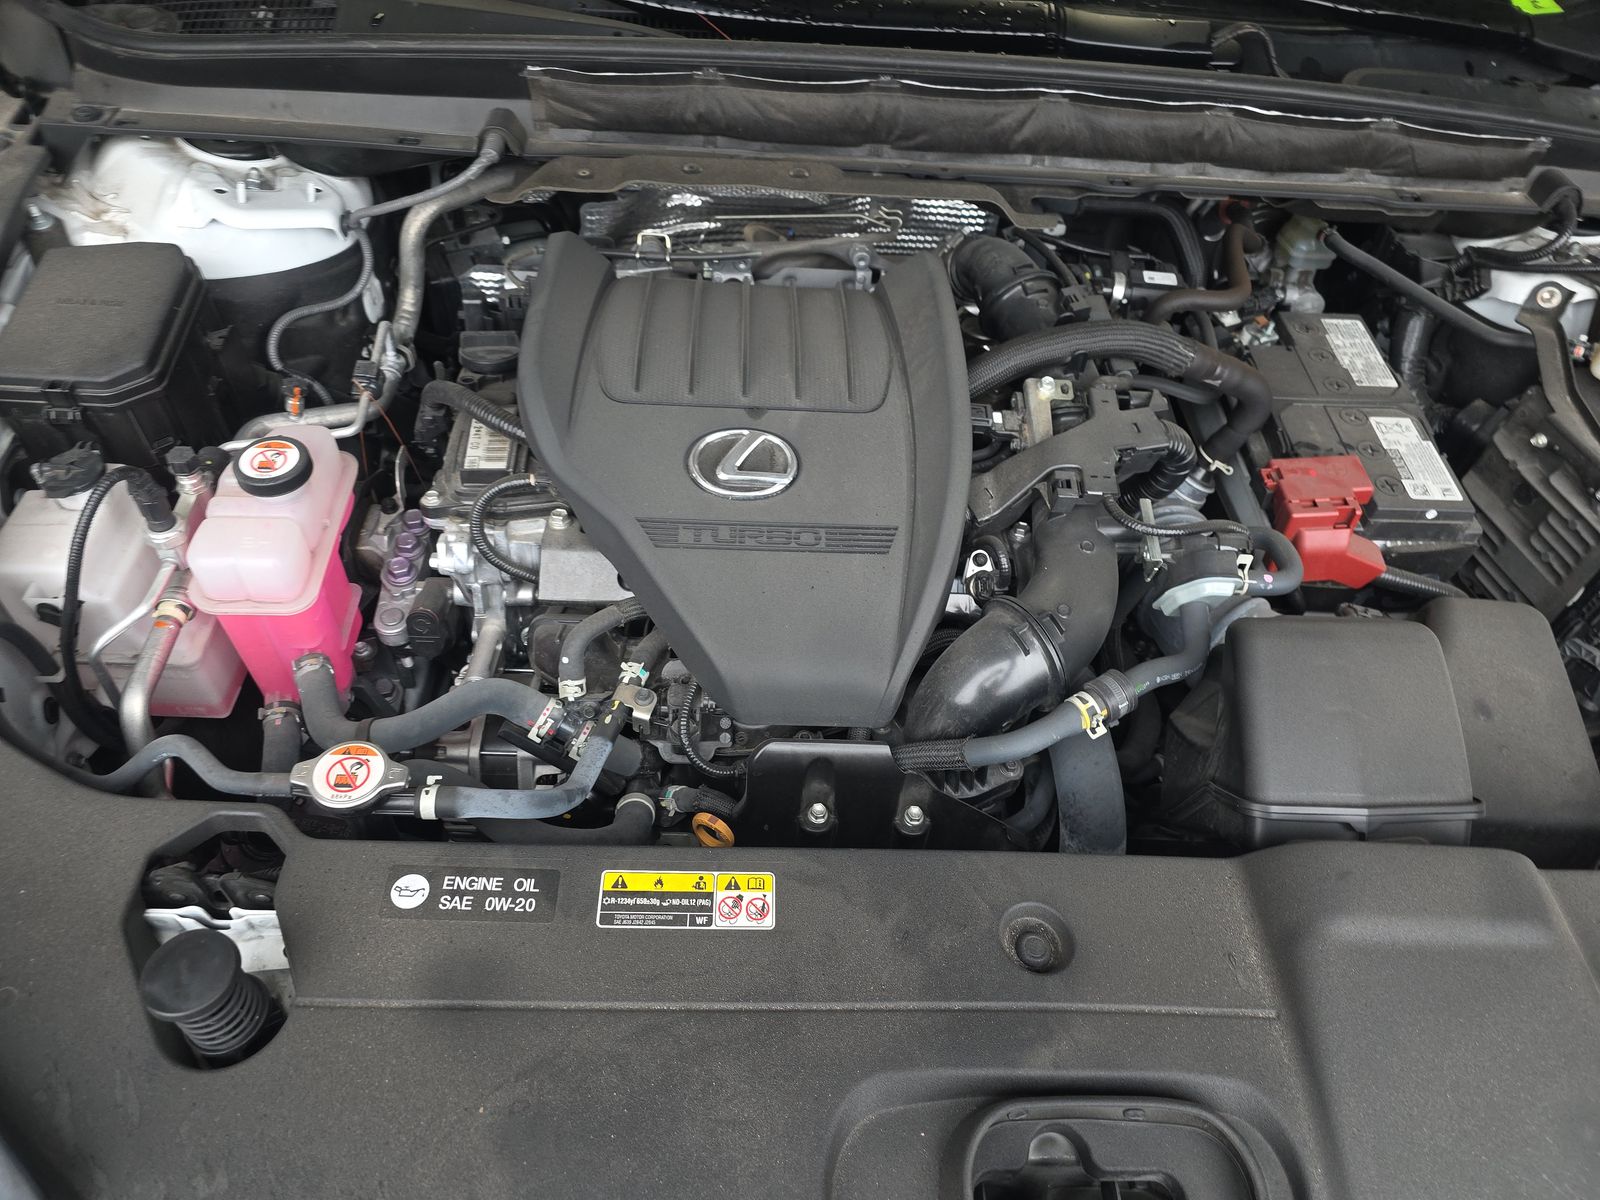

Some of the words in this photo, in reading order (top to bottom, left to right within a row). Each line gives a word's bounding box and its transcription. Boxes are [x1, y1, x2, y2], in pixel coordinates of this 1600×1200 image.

[681, 525, 823, 547] TURBO
[442, 875, 504, 891] ENGINE
[513, 877, 540, 892] OIL
[438, 895, 474, 911] SAE
[484, 896, 536, 912] 0W-20
[695, 915, 709, 925] WF
